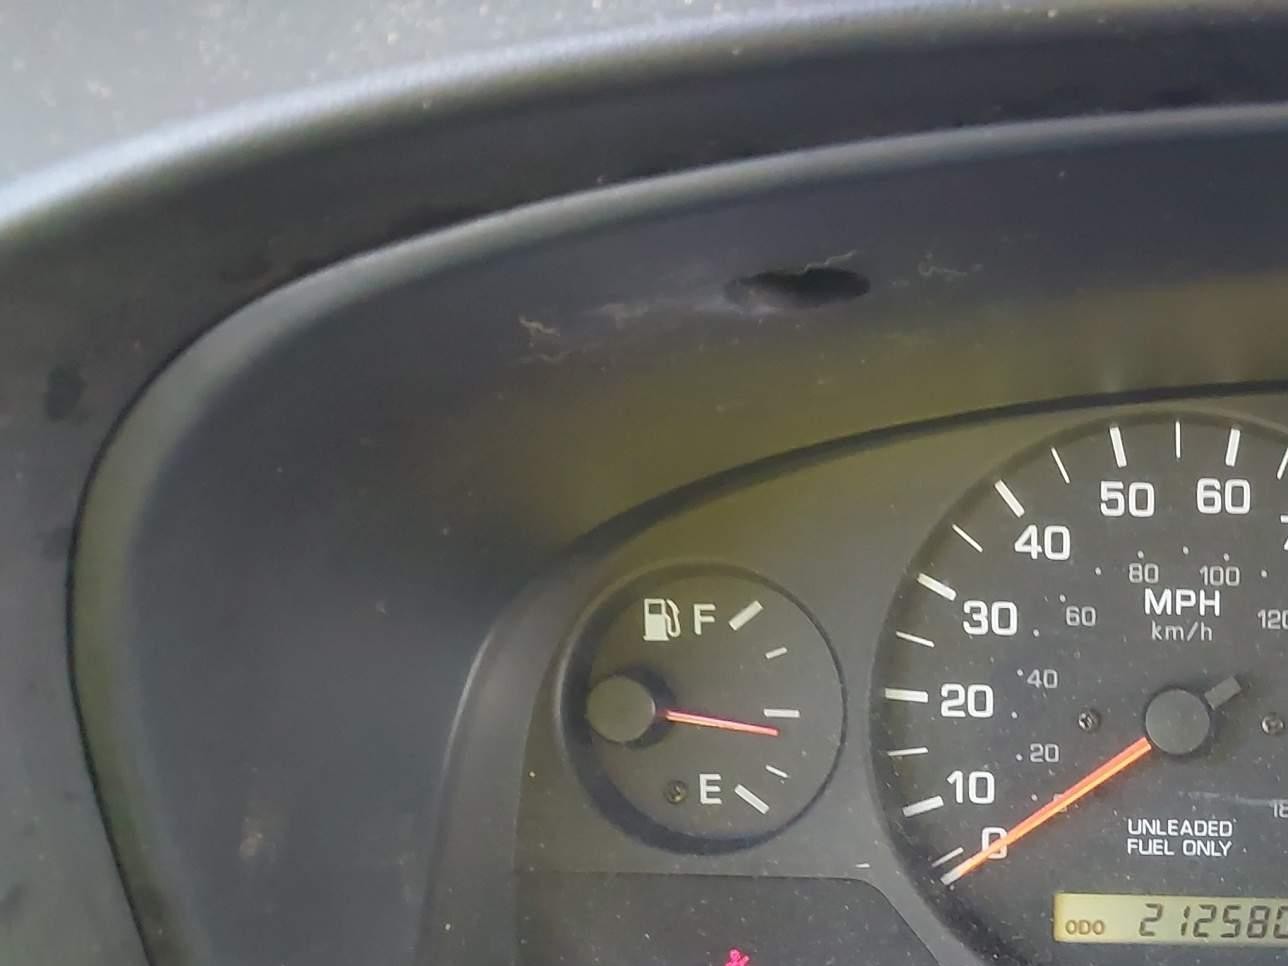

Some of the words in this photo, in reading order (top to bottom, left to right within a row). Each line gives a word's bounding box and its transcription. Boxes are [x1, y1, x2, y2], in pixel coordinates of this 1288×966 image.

[1100, 481, 1154, 517] 50
[1196, 478, 1250, 514] 60
[1014, 525, 1071, 560] 40
[1128, 563, 1159, 583] 80
[1199, 566, 1240, 586] 100
[1065, 606, 1096, 626] 60
[1144, 588, 1221, 617] MPH
[693, 603, 716, 636] F
[962, 600, 1018, 636] 30
[1151, 621, 1213, 642] km/h
[1026, 669, 1058, 689] 40
[940, 683, 994, 718] 20
[1029, 743, 1060, 763] 20
[700, 774, 722, 804] E
[946, 770, 995, 804] 10
[1127, 818, 1233, 836] UNLEADED
[981, 827, 1008, 859] 0
[1127, 839, 1175, 856] FUEL
[1182, 839, 1233, 857] ONLY
[1064, 919, 1106, 937] ODO
